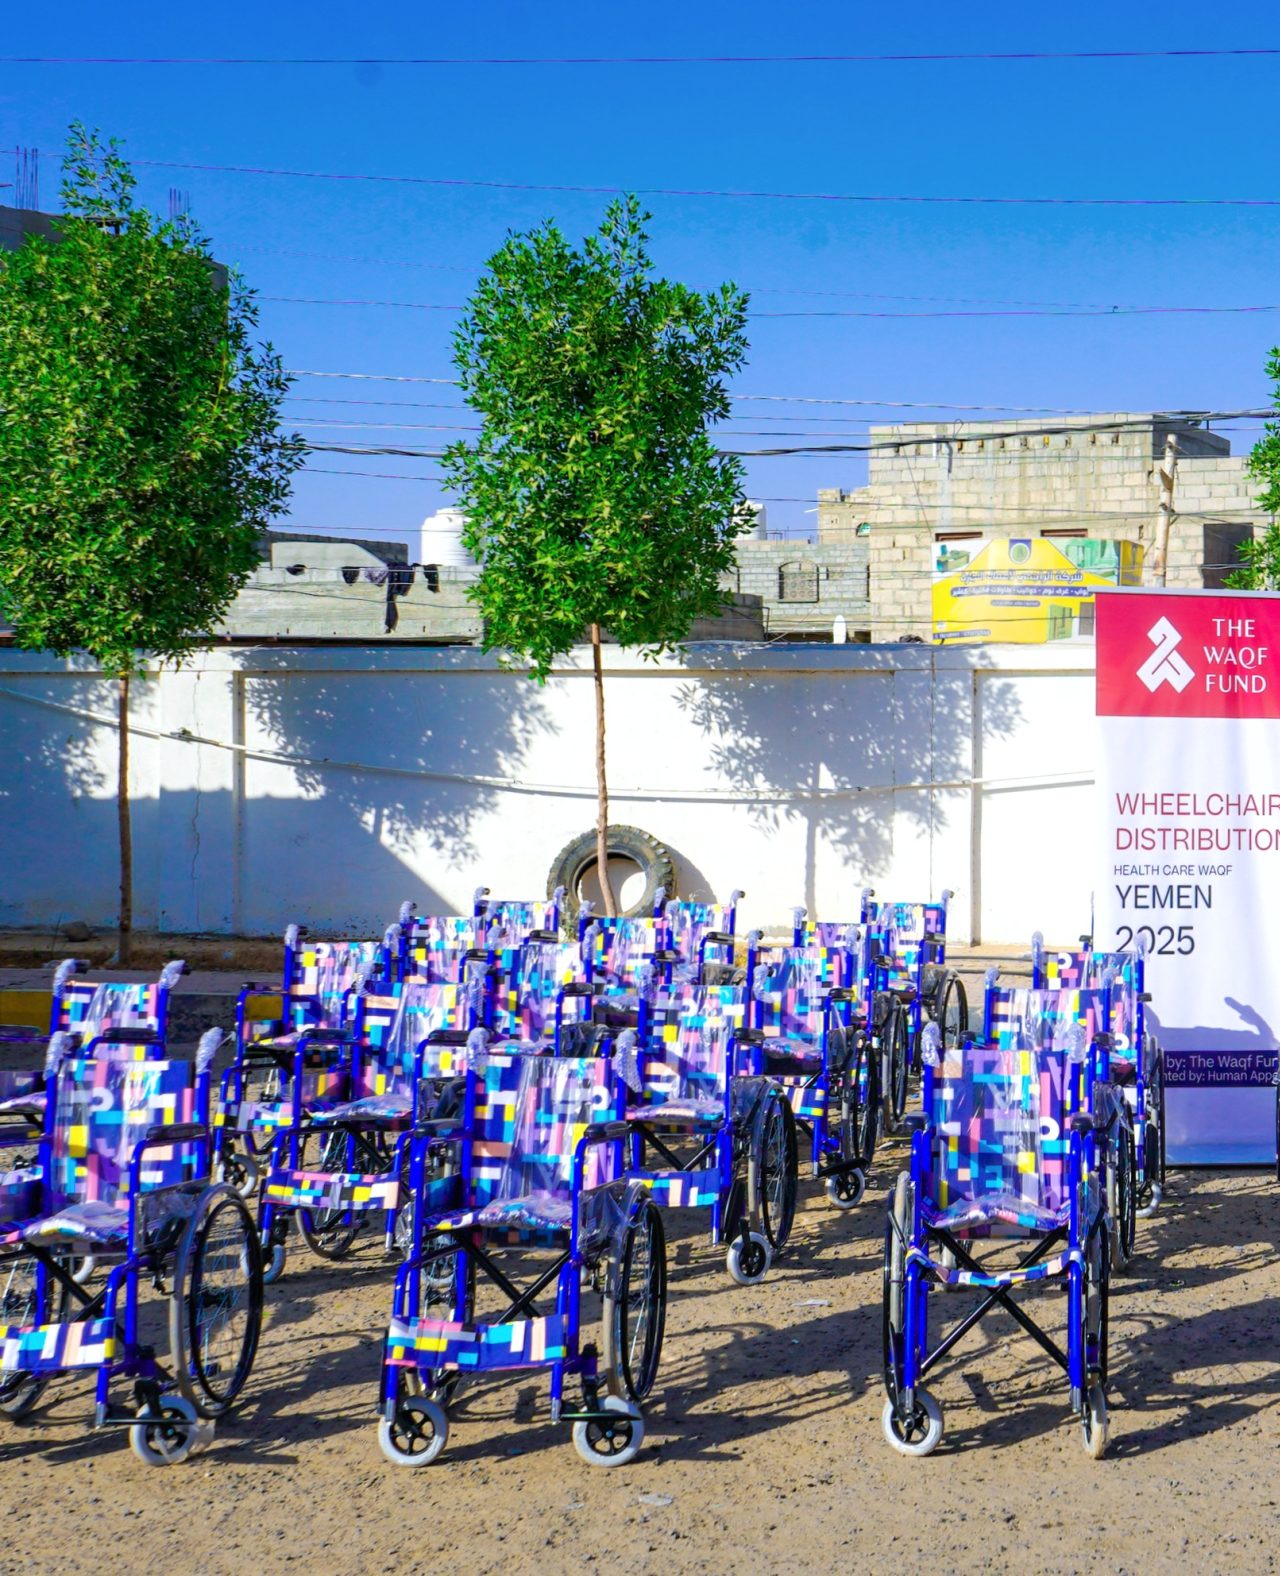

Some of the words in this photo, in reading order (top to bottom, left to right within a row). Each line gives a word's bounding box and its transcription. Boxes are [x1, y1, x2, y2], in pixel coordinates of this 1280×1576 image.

[1055, 570, 1083, 584] شركة
[1212, 618, 1255, 638] THE
[1203, 646, 1268, 669] WAQF
[1205, 674, 1266, 693] FUND
[1114, 864, 1160, 876] HEALTH
[1162, 864, 1195, 876] CARE
[1198, 864, 1233, 876] WAQF
[1115, 884, 1212, 909] YEMEN
[1116, 925, 1195, 955] 2025
[1166, 1055, 1186, 1071] by:
[1189, 1055, 1215, 1068] The
[1218, 1054, 1253, 1071] Waqf
[1163, 1071, 1186, 1081] nted
[1188, 1070, 1205, 1083] by:
[1208, 1070, 1248, 1081] Human
[1250, 1071, 1278, 1083] Appe
